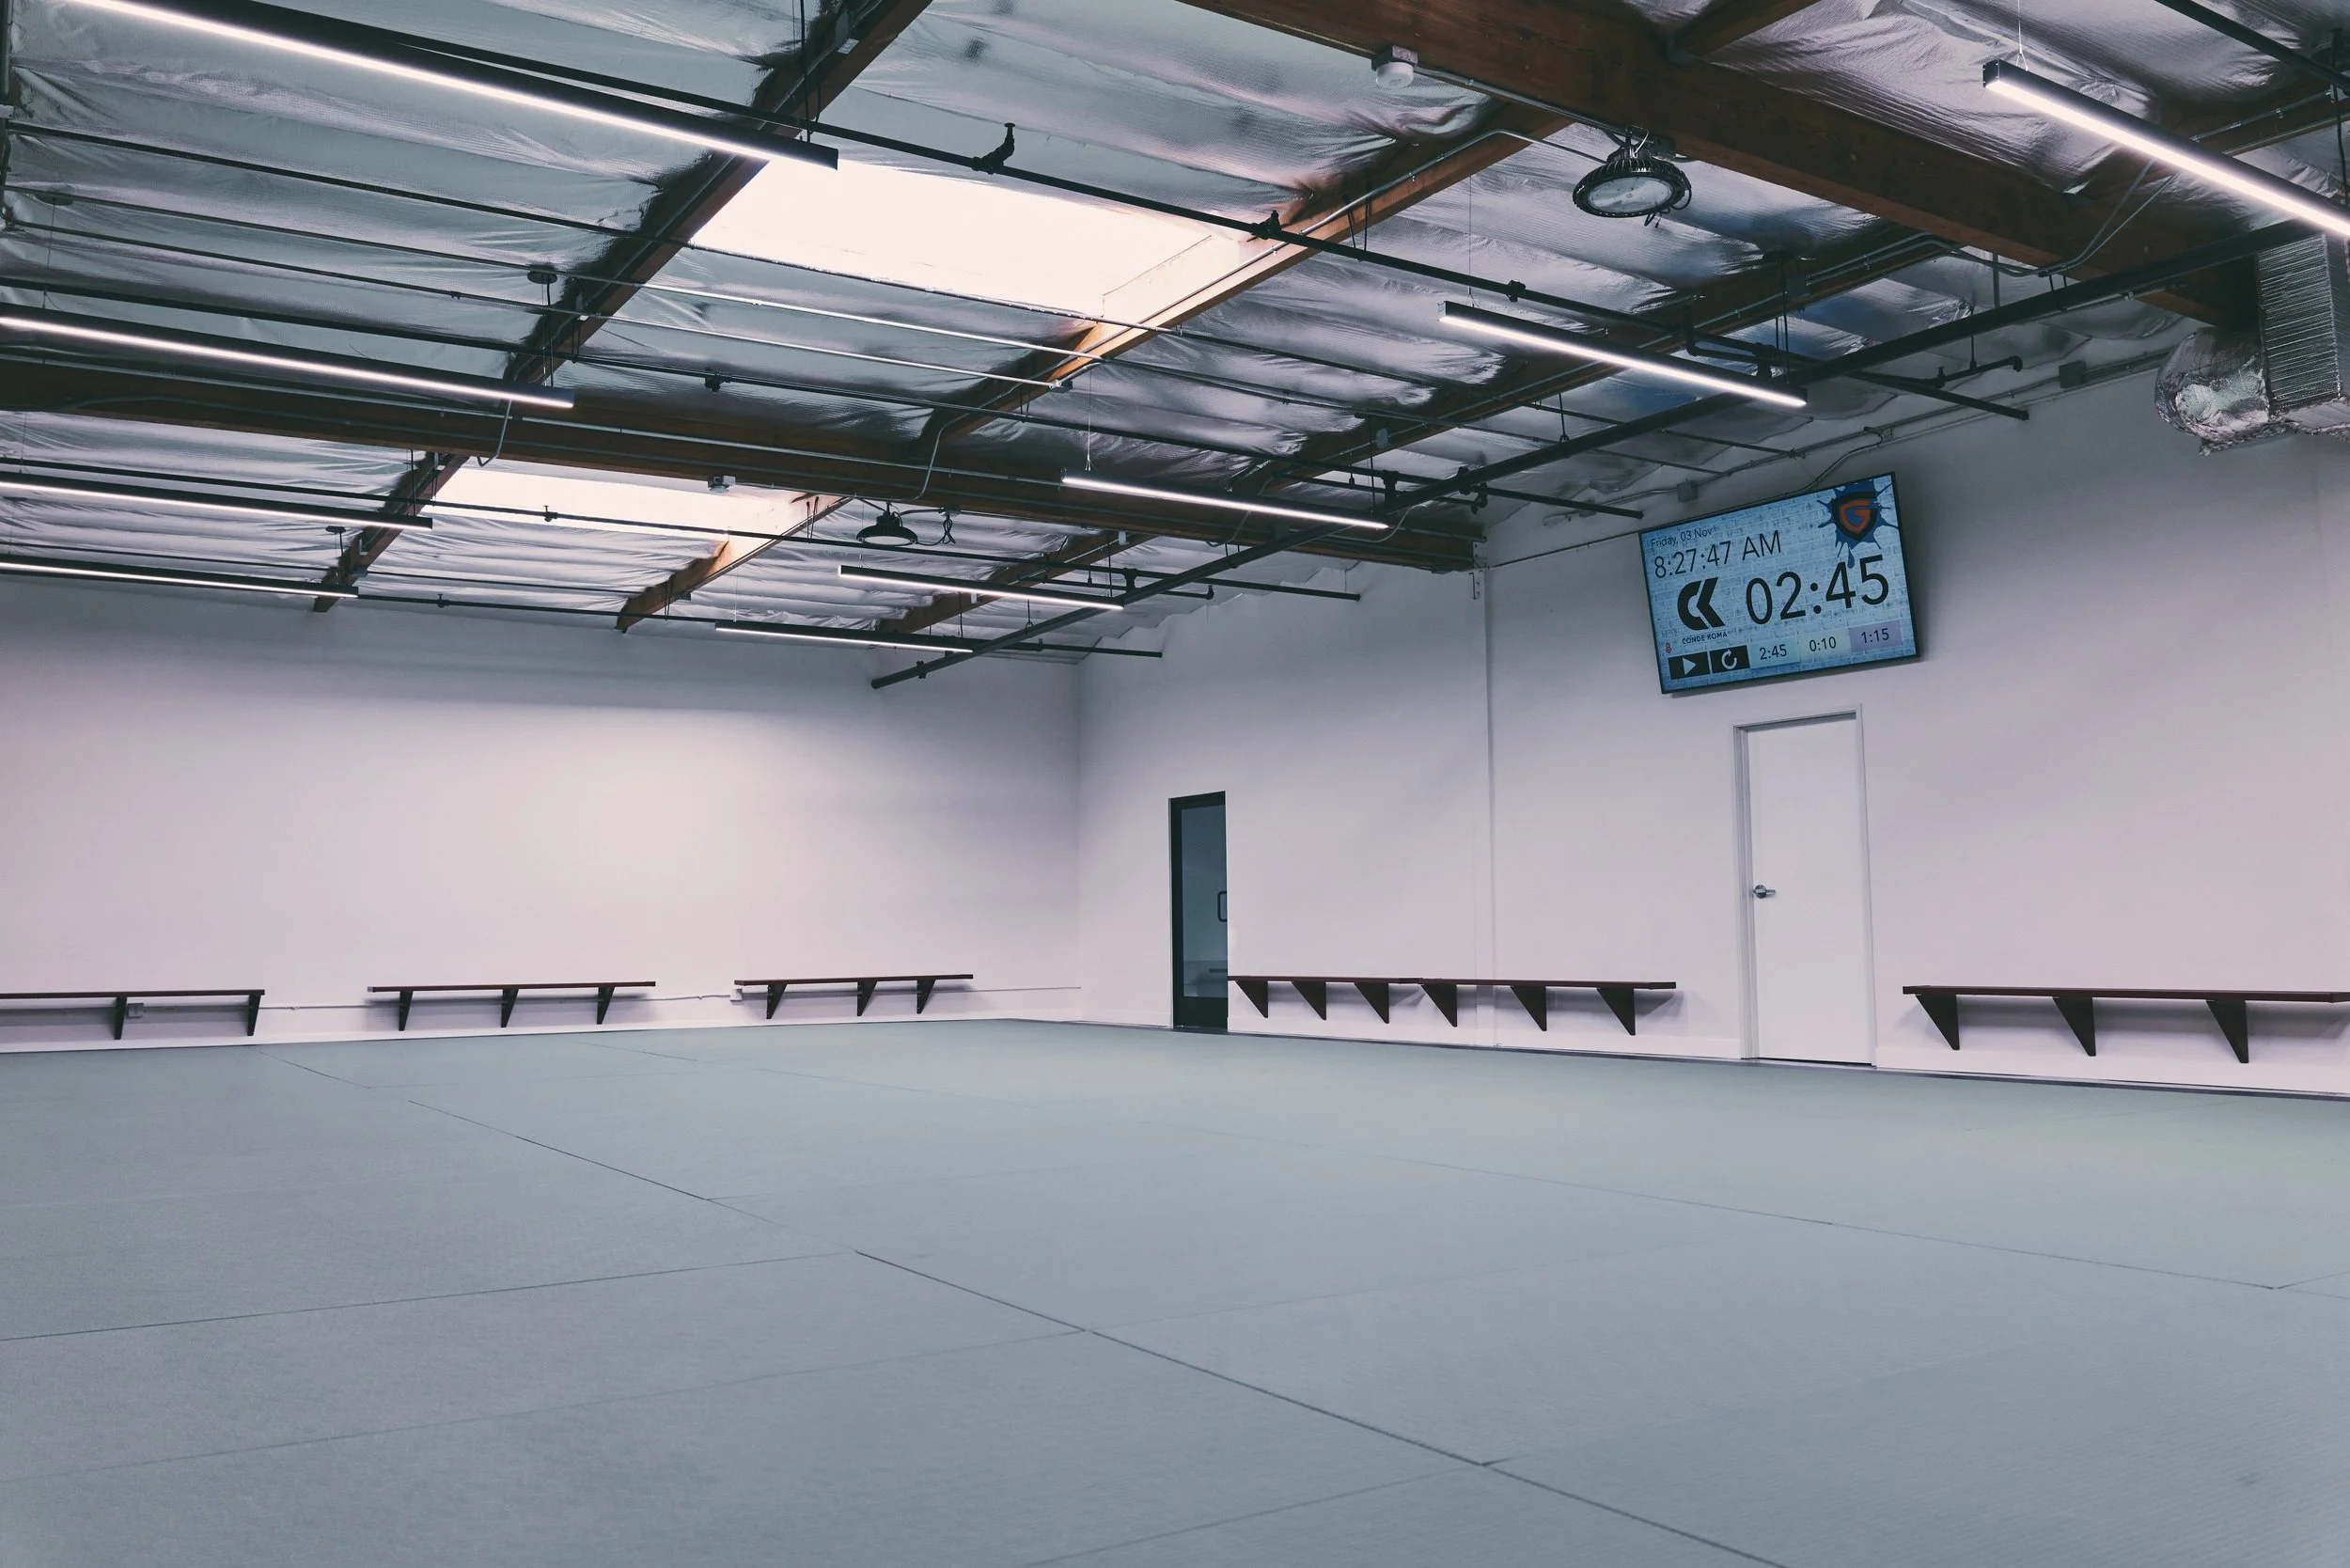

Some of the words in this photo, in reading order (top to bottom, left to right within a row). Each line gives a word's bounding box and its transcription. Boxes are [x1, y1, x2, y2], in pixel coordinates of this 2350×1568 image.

[1650, 537, 1679, 549] Friday,
[1680, 530, 1692, 542] 03
[1694, 526, 1713, 540] Nov
[1654, 541, 1731, 578] 8:27:47
[1742, 530, 1781, 561] AM
[1746, 555, 1889, 625] 02:45
[1682, 634, 1706, 645] CONDE
[1707, 631, 1728, 642] KOMA
[1809, 636, 1837, 651] 0:10
[1861, 628, 1889, 644] 1:15
[1760, 644, 1787, 660] 2:45
